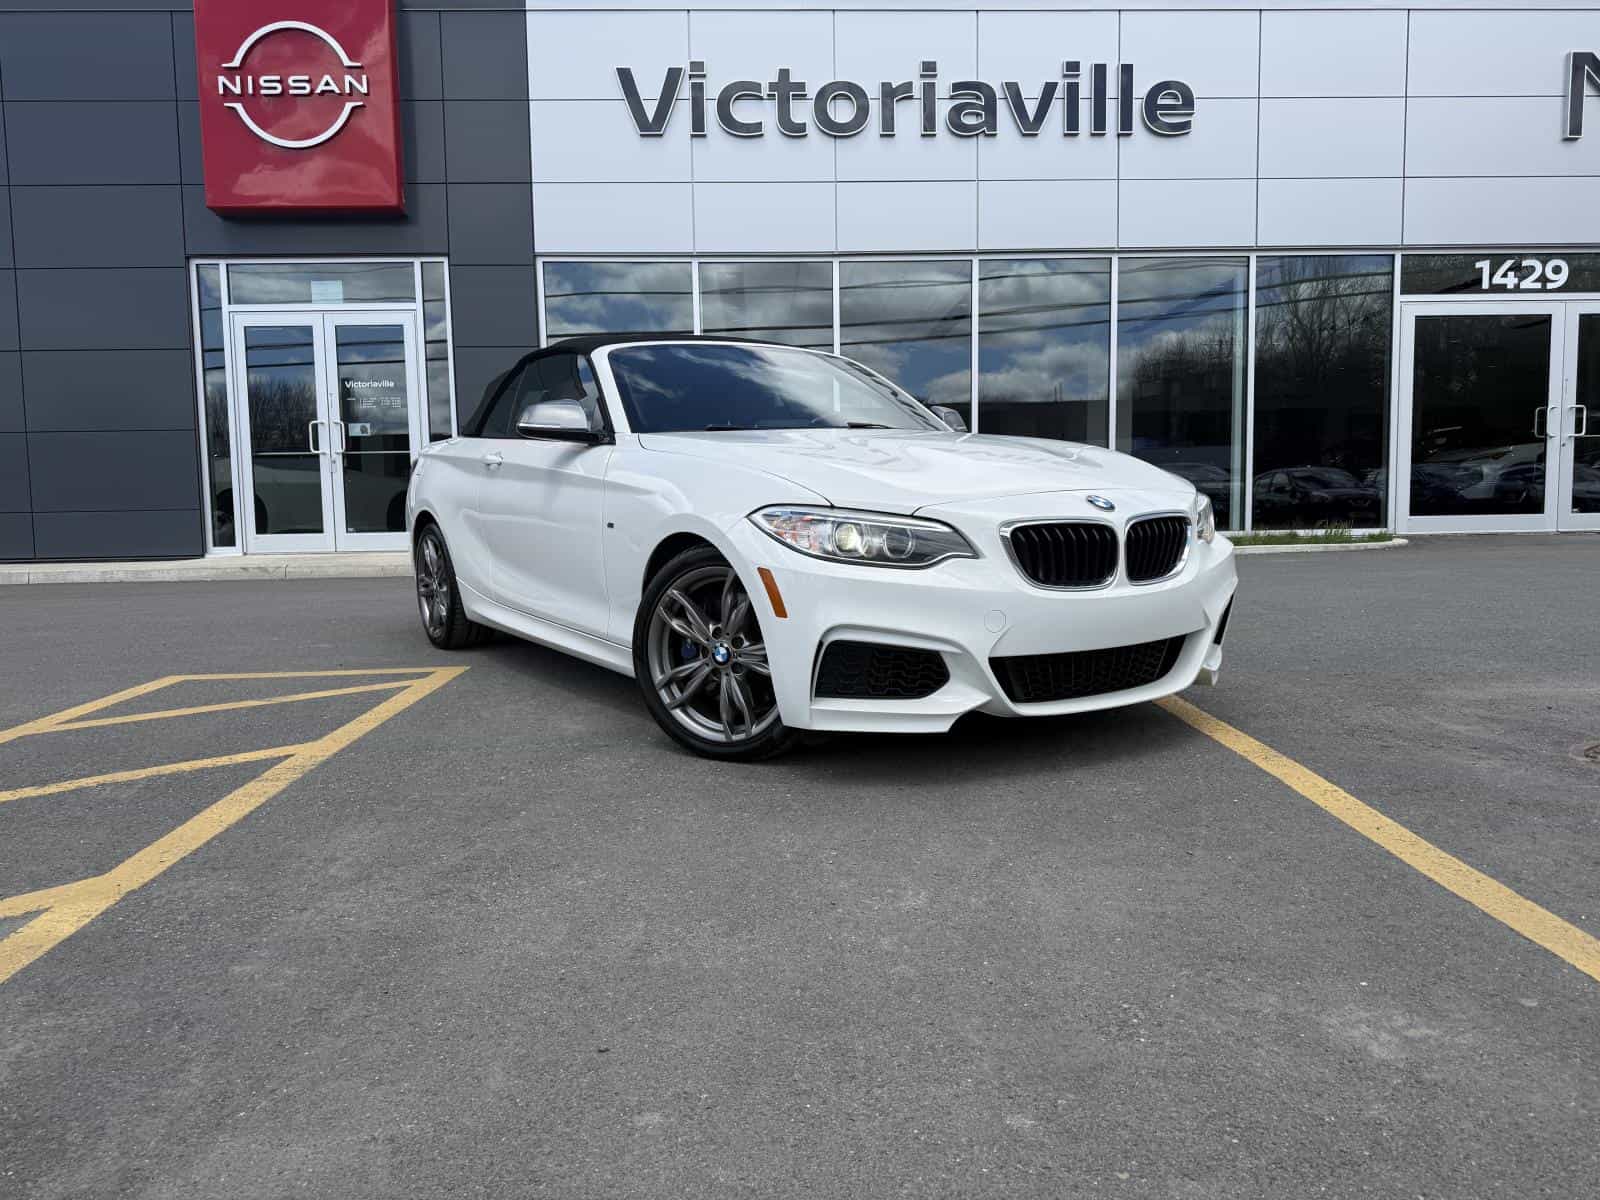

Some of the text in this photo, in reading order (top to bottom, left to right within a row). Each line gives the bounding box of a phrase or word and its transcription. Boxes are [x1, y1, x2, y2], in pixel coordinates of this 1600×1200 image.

[217, 74, 369, 96] NISSAN
[615, 60, 1196, 137] Victoriaville
[1475, 259, 1569, 290] 1429
[344, 379, 395, 389] Victoriaville
